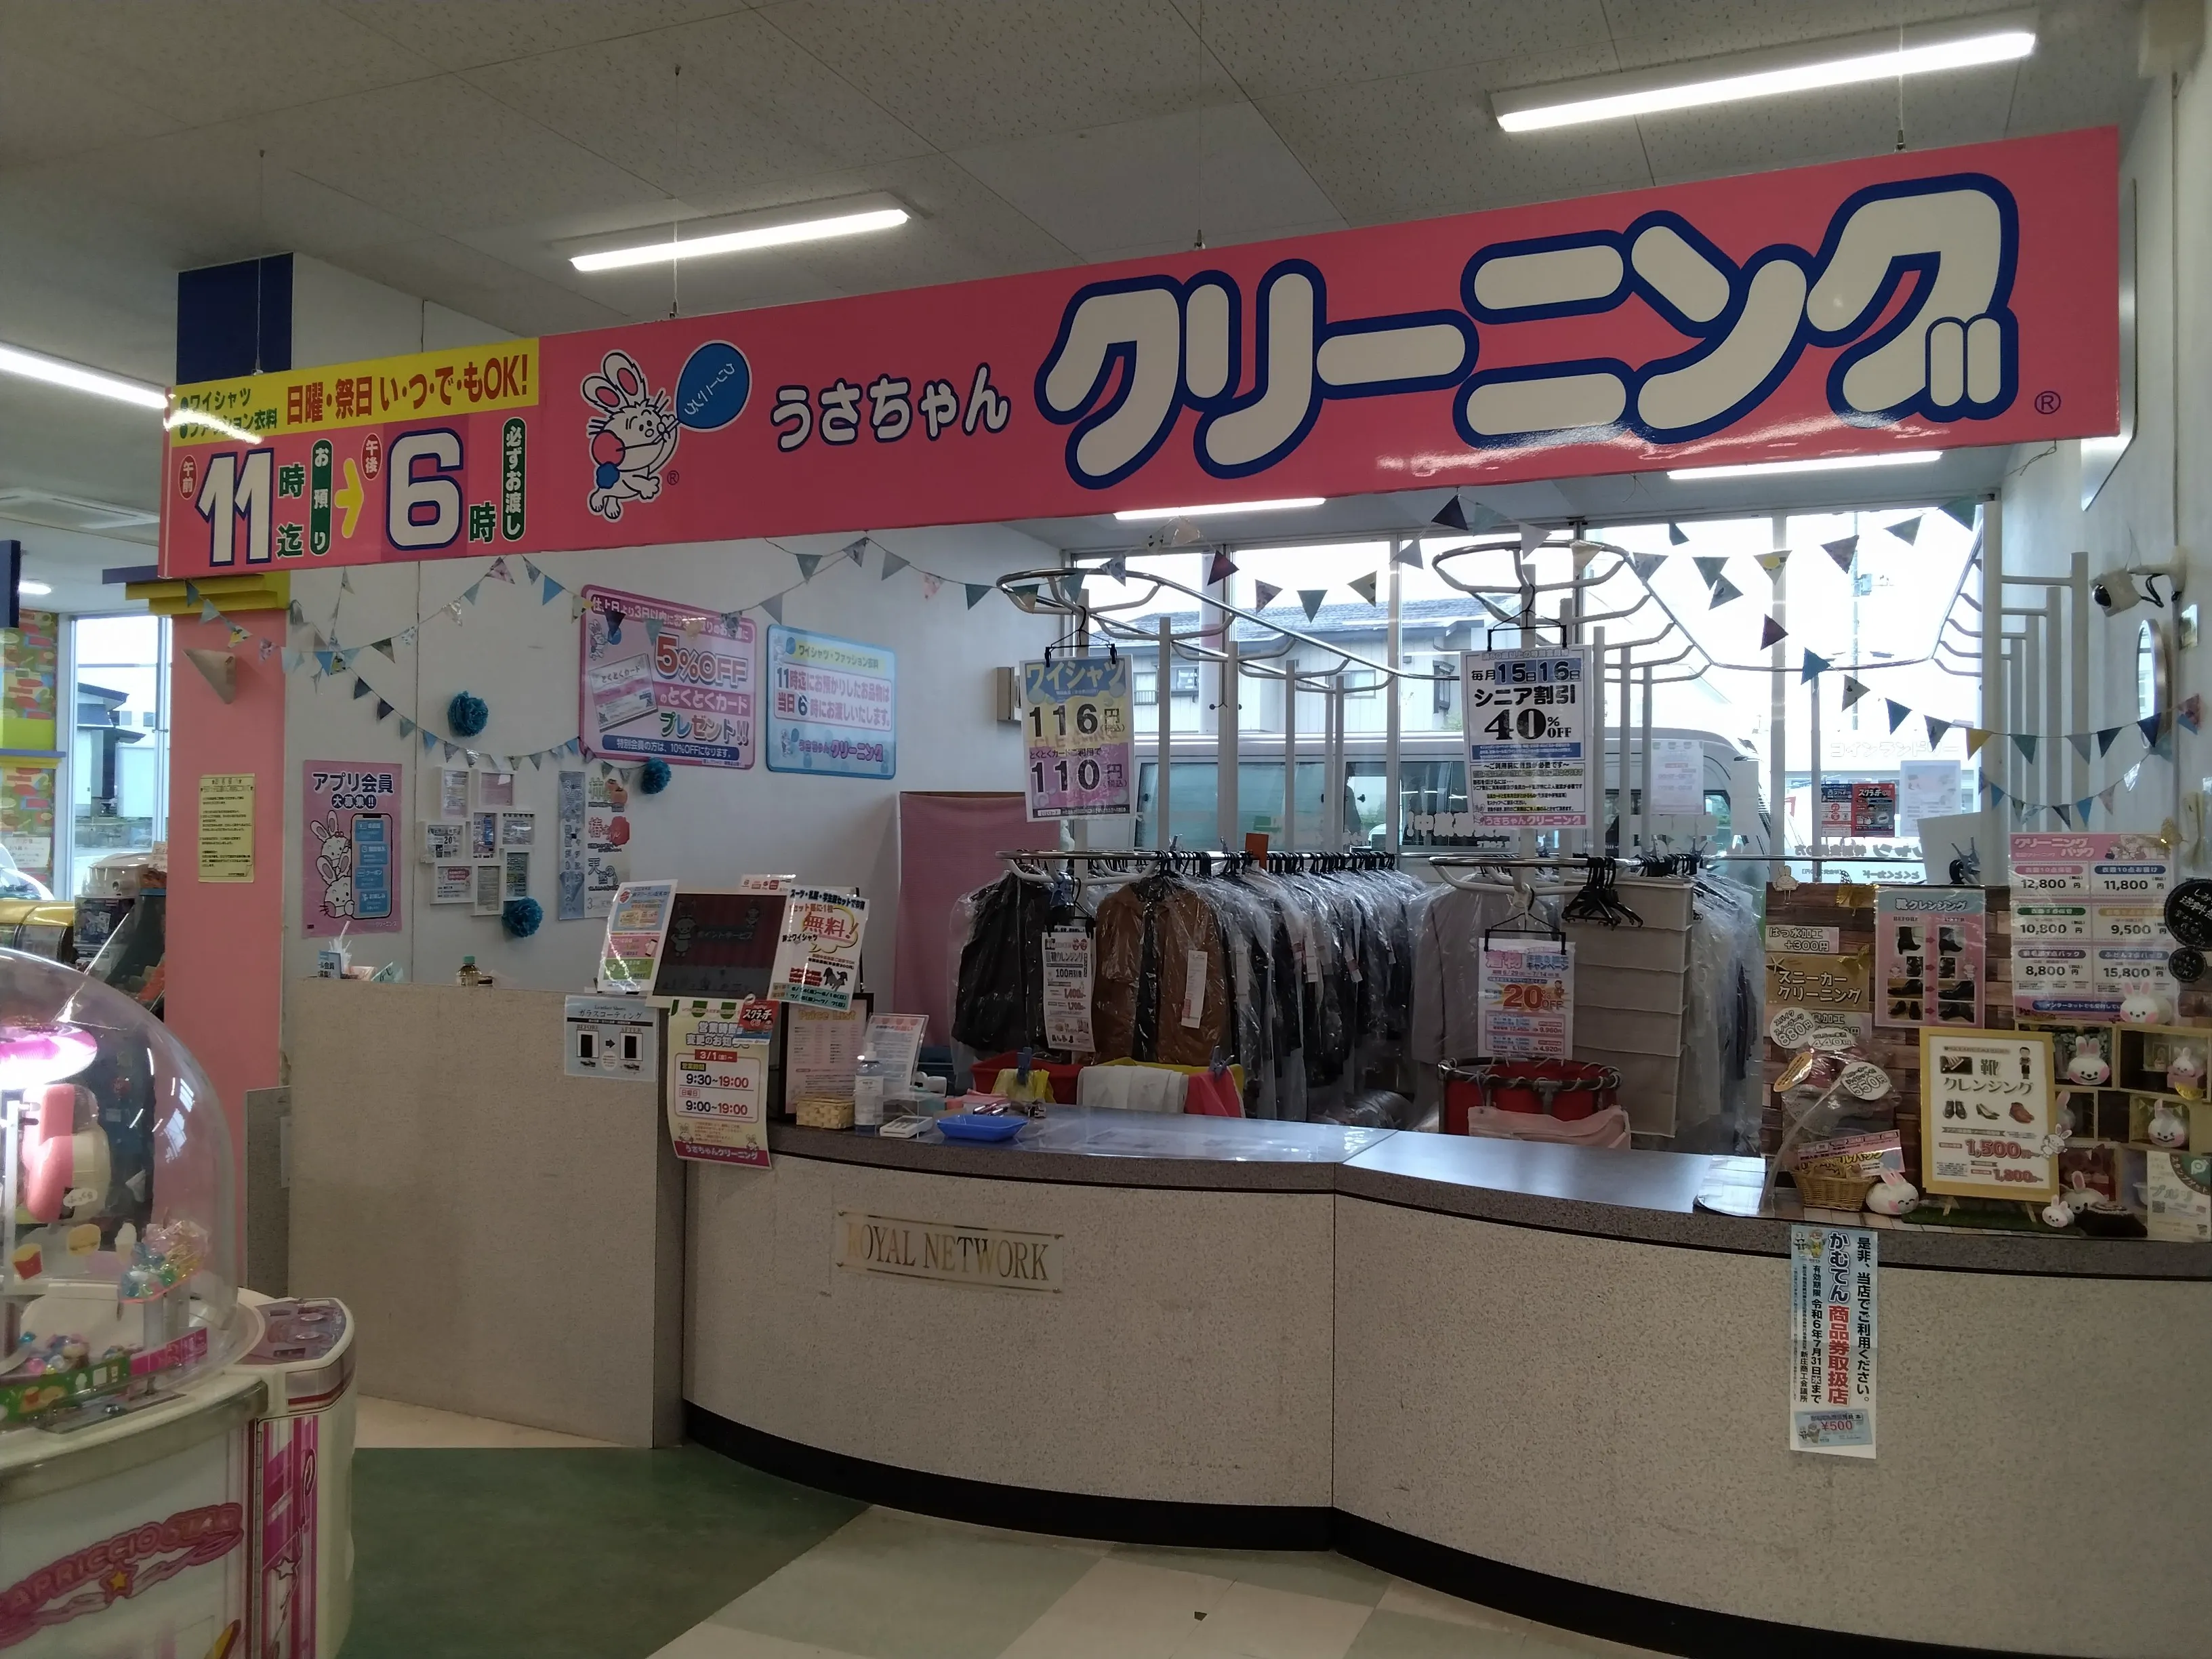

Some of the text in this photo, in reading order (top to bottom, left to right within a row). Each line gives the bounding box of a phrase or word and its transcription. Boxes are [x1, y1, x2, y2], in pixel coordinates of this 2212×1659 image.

[1035, 172, 2019, 491] クリーニング
[770, 362, 1011, 452] うさちゃん
[365, 438, 379, 475] 午後
[182, 461, 195, 493] 午前
[505, 424, 525, 537] 必ずお渡し
[386, 428, 464, 550] 6
[195, 447, 274, 567] 11
[468, 501, 496, 543] 時
[655, 632, 748, 689] 5%OFF
[1027, 660, 1124, 691] ワイシャツ
[1474, 684, 1576, 708] シニア割引
[1029, 703, 1099, 737] 116
[1484, 709, 1547, 741] 40
[1547, 727, 1572, 738] OFF
[1031, 758, 1101, 794] 110
[1107, 764, 1122, 779] 円
[312, 772, 394, 794] アプリ会員
[1485, 815, 1581, 826] うさちゃんクリーニング
[2014, 837, 2089, 848] クリーニング
[2060, 847, 2095, 857] パック
[2021, 879, 2067, 890] 12,800
[2103, 880, 2148, 891] 11,800
[804, 912, 860, 940] 無料!
[1769, 927, 1823, 939] はっ水加工
[2020, 924, 2067, 935] 10,800
[2110, 924, 2152, 935] 9,500
[1784, 940, 1830, 951] +300円
[1486, 949, 1523, 969] 着物
[1778, 970, 1847, 986] スニーカー
[2025, 966, 2066, 977] 8,800
[2103, 966, 2150, 978] 15,800
[1502, 983, 1543, 1010] 20
[1541, 1000, 1564, 1010] OFF
[1778, 986, 1862, 1004] クリーニング
[579, 1009, 642, 1019] ガラスコーティング
[686, 1033, 750, 1049] 変更のお知
[1777, 1019, 1814, 1046] 880円
[1980, 1059, 2000, 1076] 靴
[1849, 1074, 1888, 1097] 550円
[1944, 1077, 2035, 1096] クレンジング
[846, 1222, 1050, 1282] ROYAL NETWORK
[1828, 1231, 1851, 1303] かむてん
[1812, 1265, 1822, 1297] 有効期限
[1828, 1305, 1850, 1406] 商品券取扱店
[1821, 1420, 1853, 1431] ¥500
